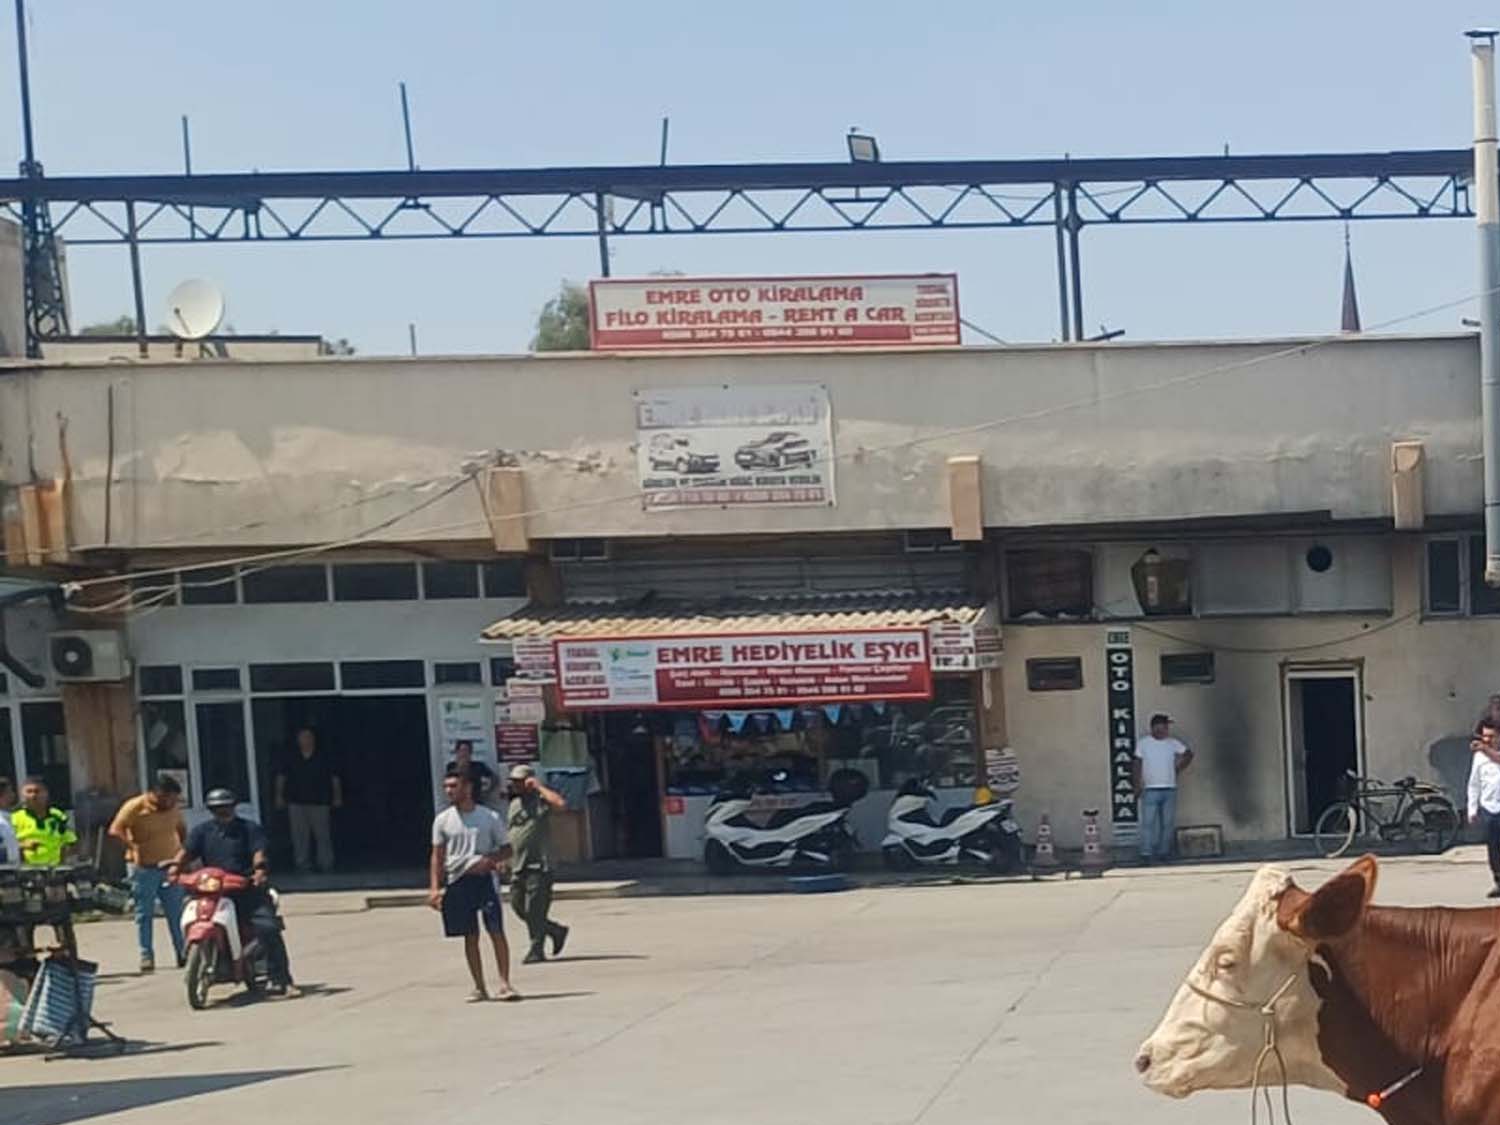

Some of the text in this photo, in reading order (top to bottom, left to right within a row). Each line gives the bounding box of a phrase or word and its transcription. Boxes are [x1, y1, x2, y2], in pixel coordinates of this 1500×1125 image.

[646, 284, 864, 304] EMRE OTO KİRALAMA
[605, 308, 649, 327] FİLO
[656, 307, 763, 326] KİRALAMA
[784, 307, 838, 323] RENT
[844, 306, 859, 322] A
[865, 306, 906, 322] CAR
[657, 645, 723, 664] EMRE
[731, 639, 856, 662] HEDİYELİK
[863, 640, 920, 662] EŞYA
[1110, 652, 1130, 692] OTO
[1112, 707, 1135, 818] KİRALAMA
